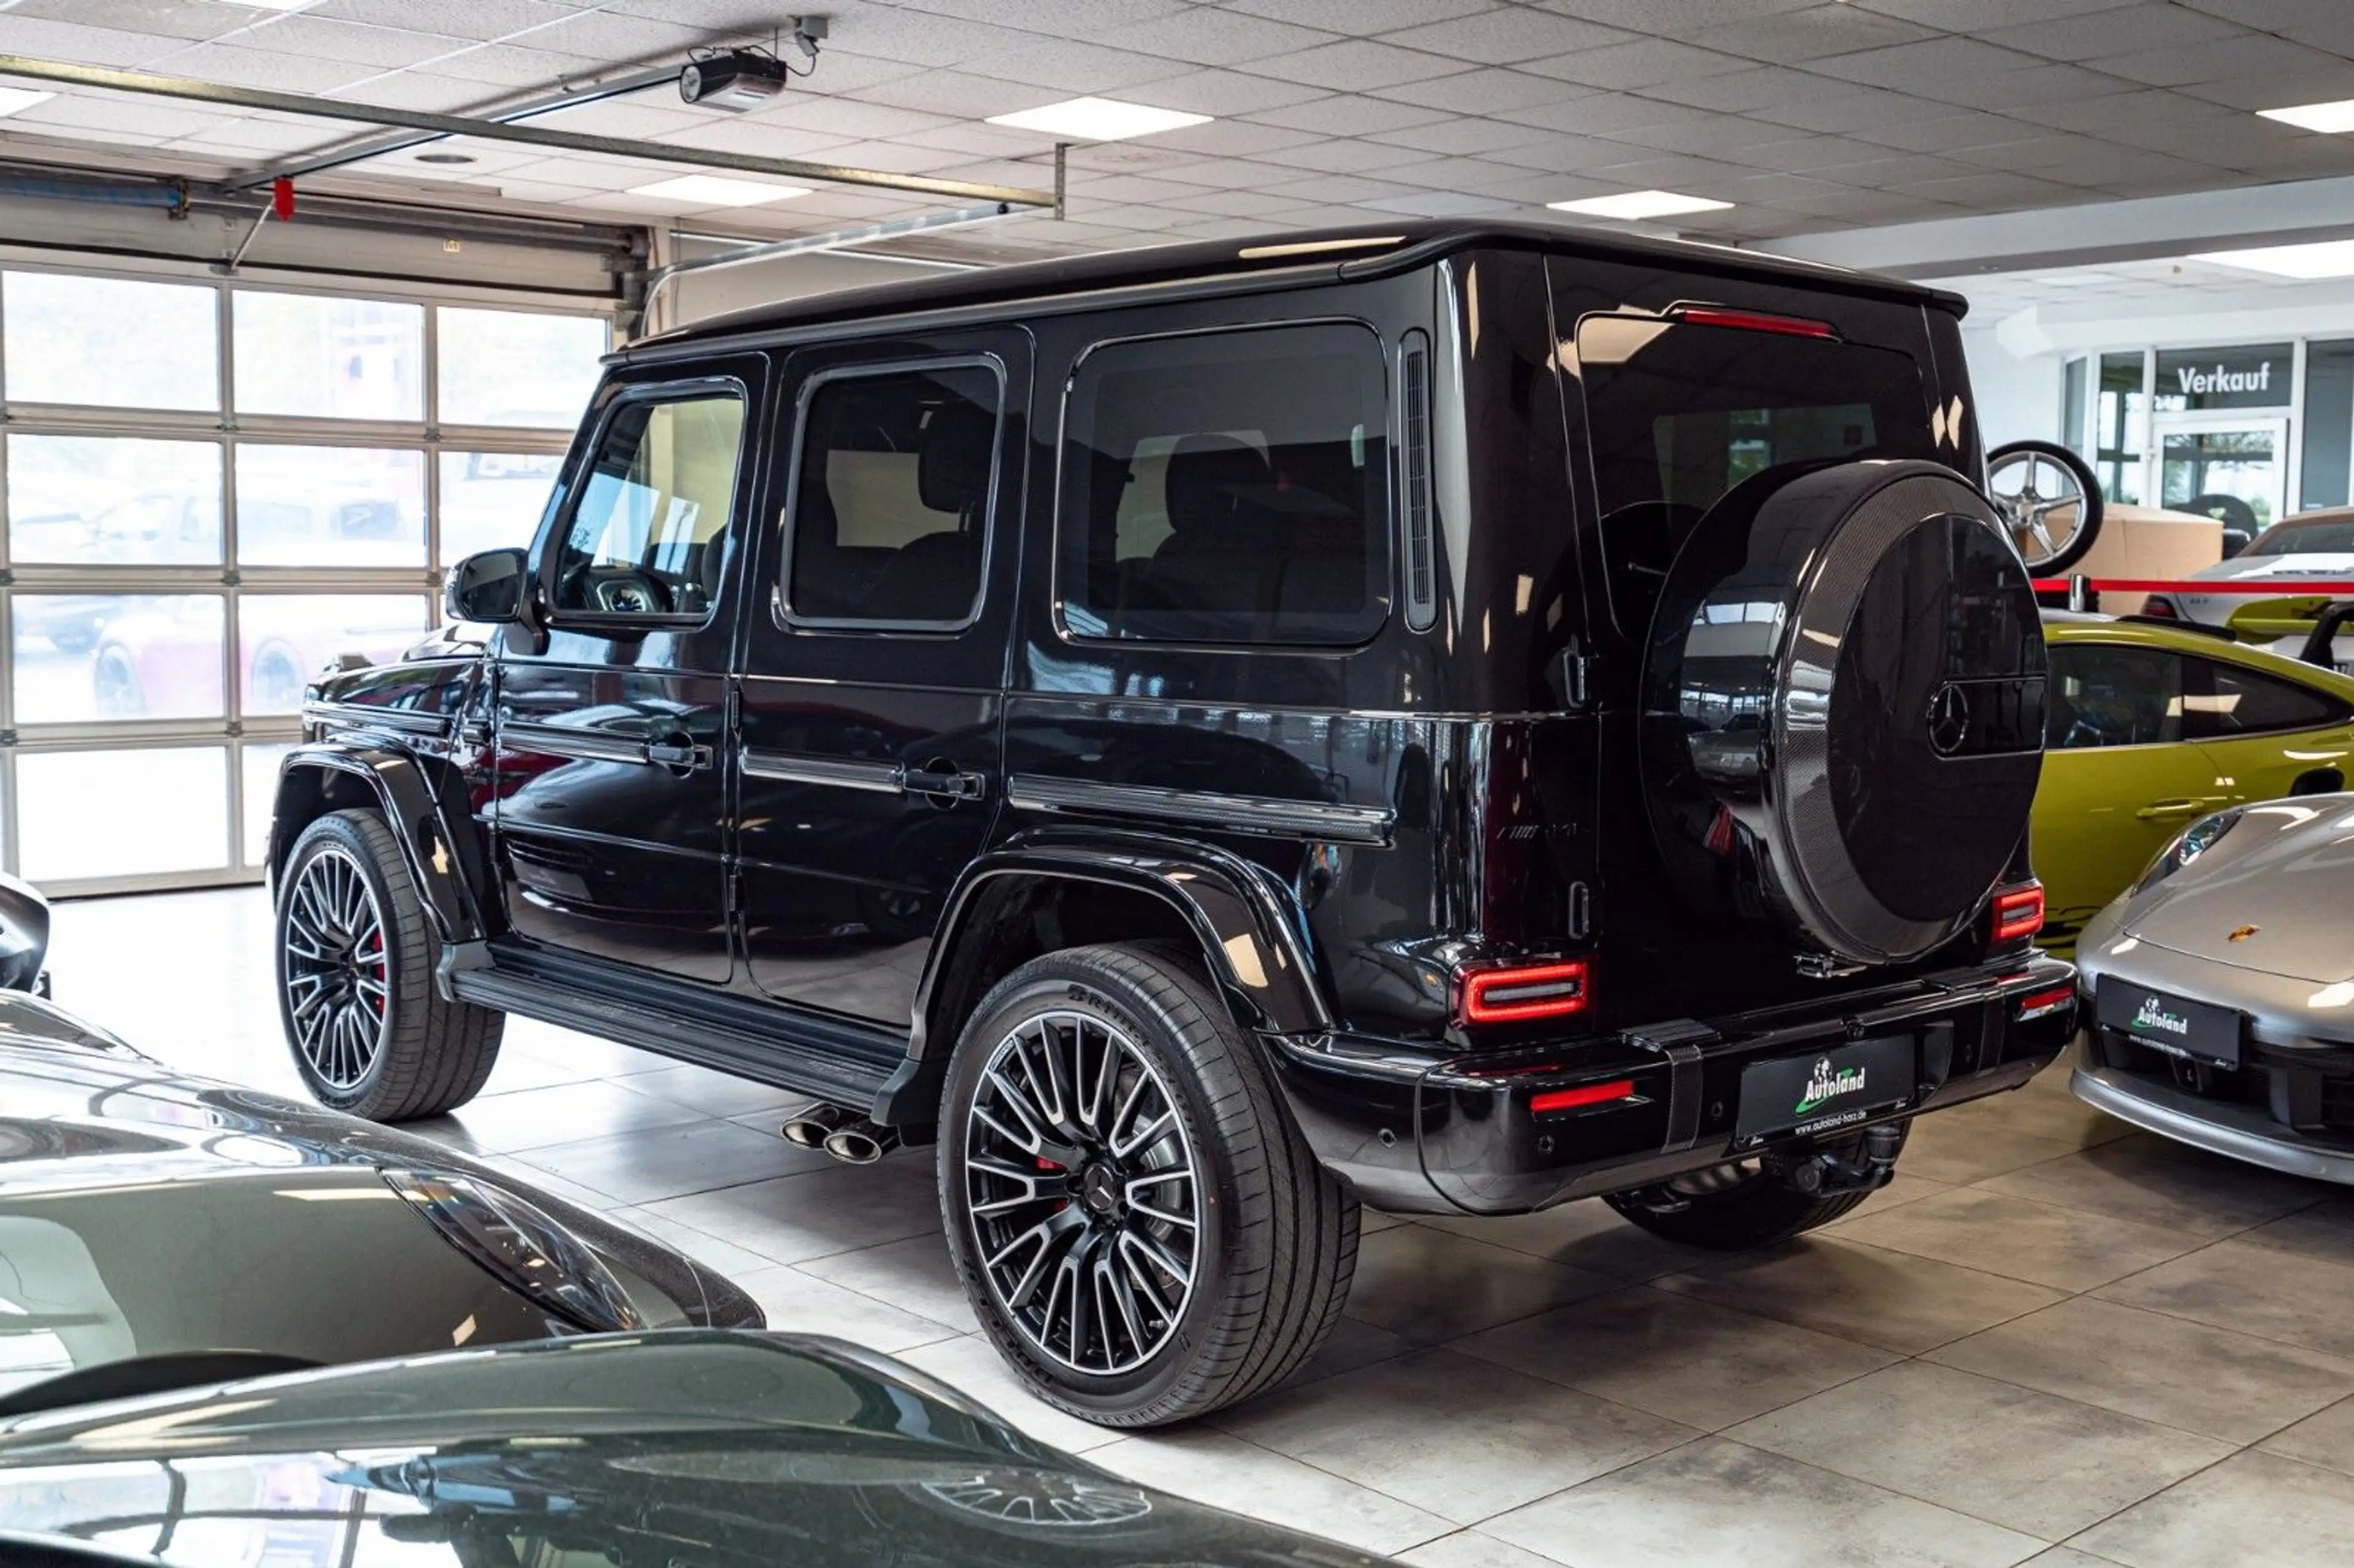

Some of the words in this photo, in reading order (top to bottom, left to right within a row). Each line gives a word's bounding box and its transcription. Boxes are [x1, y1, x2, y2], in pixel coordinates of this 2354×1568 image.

[2177, 362, 2271, 394] Verkauf
[2138, 1007, 2187, 1034] Autoland
[1805, 1067, 1865, 1101] Autoland
[1795, 1109, 1867, 1135] www.autoland-harz.de
